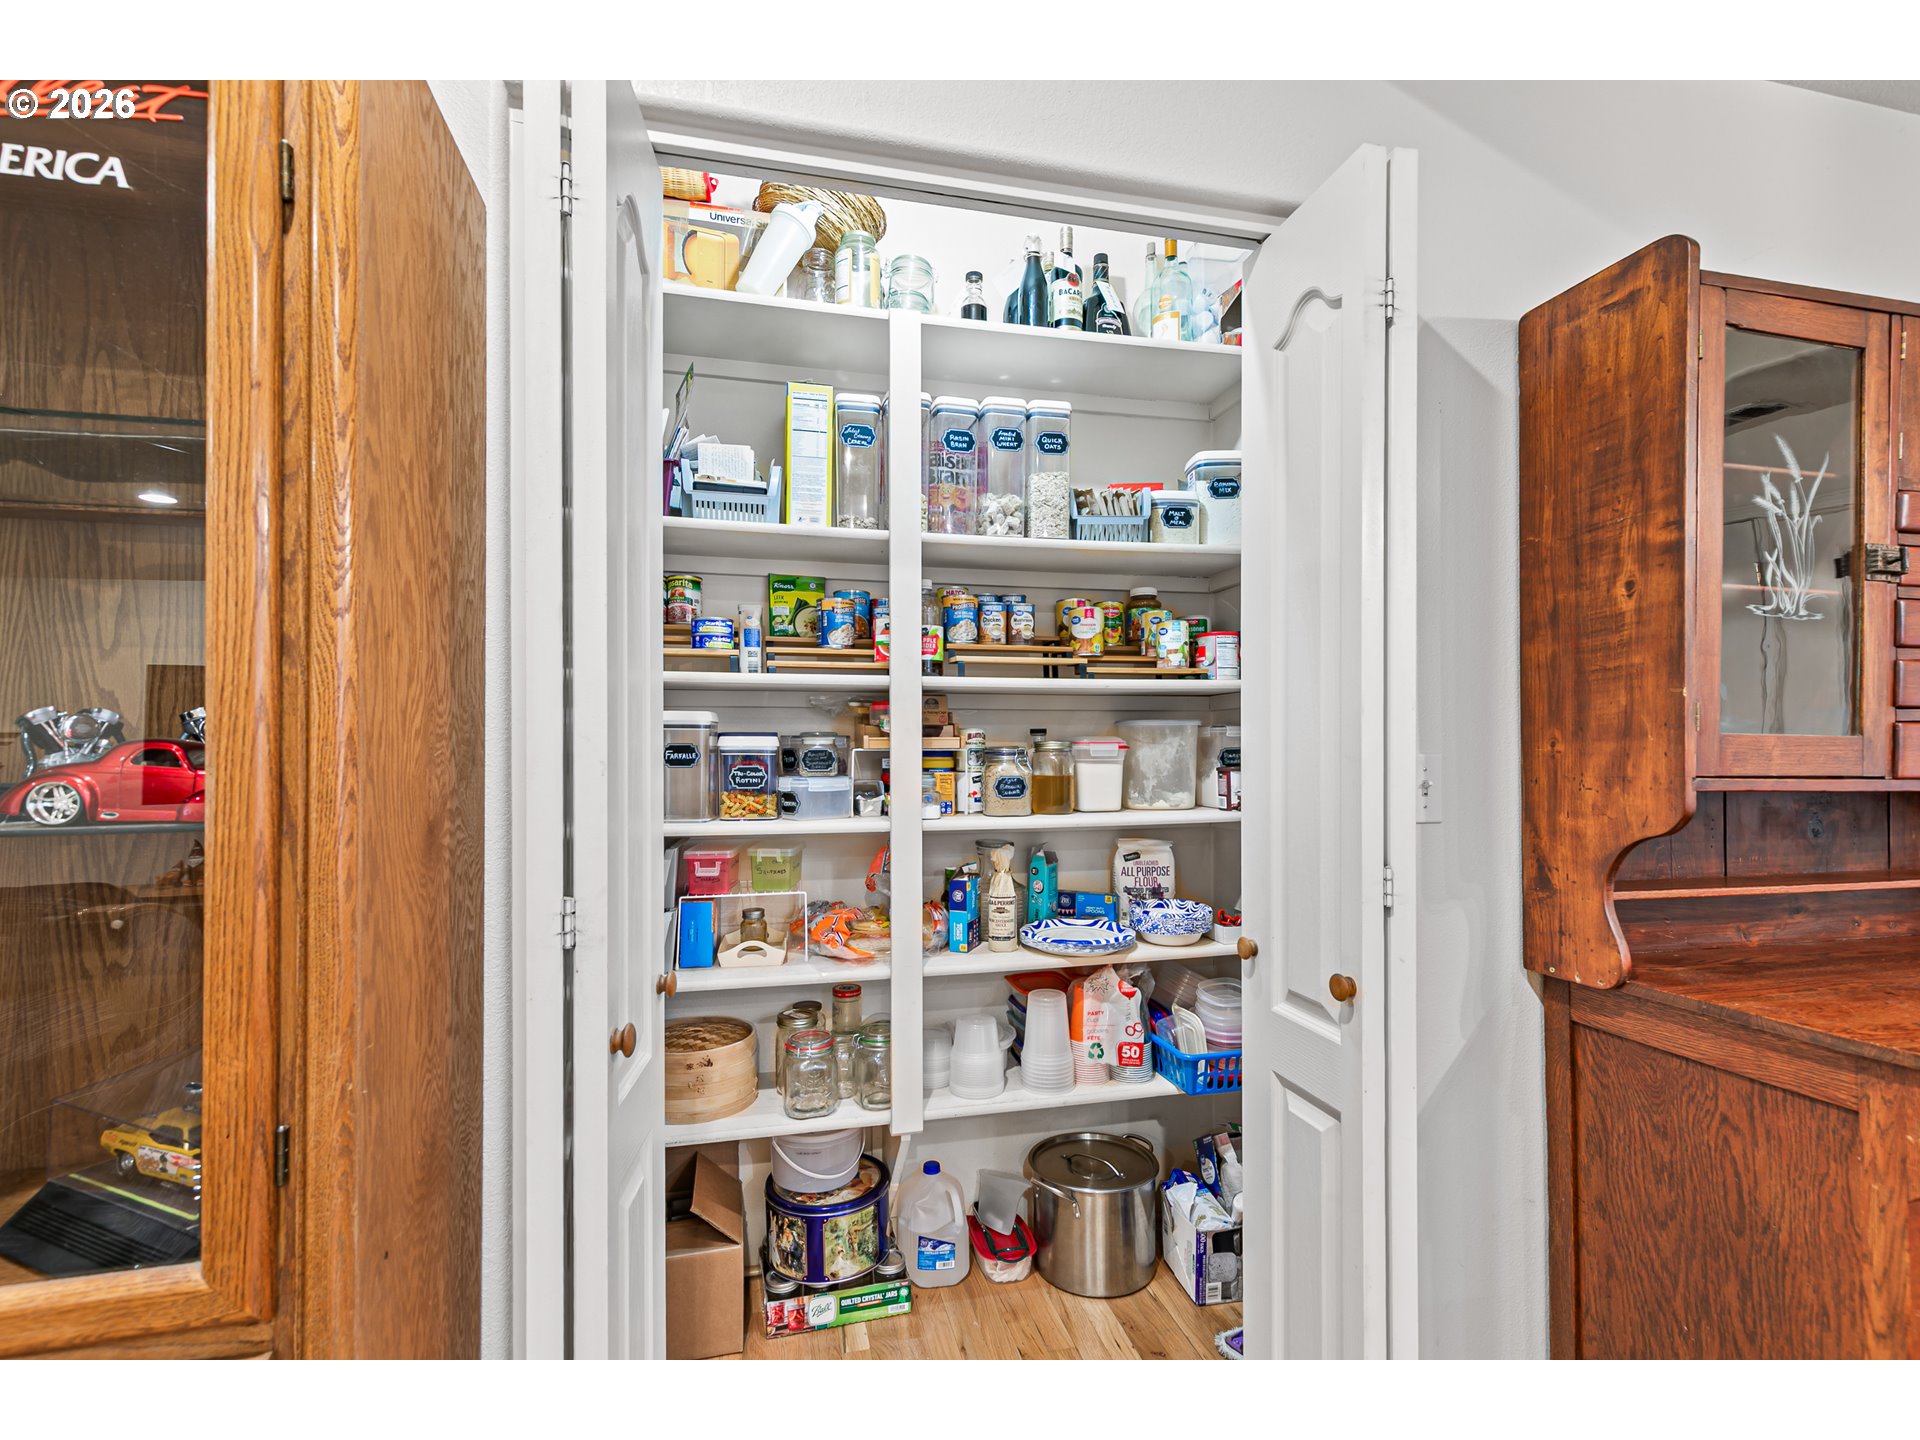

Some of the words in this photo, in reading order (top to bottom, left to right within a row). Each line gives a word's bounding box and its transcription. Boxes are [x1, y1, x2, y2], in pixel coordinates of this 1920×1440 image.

[1041, 436, 1063, 444] QUICK
[773, 582, 795, 590] Knorr
[665, 750, 697, 760] FARFALLE
[1120, 866, 1135, 876] ALL
[1136, 866, 1171, 877] PURPOSE
[1134, 876, 1159, 887] FLOUR
[1121, 1045, 1140, 1058] 50
[840, 1296, 862, 1306] QUILTED
[862, 1293, 884, 1303] CRYSTAL
[885, 1290, 898, 1299] JARS
[811, 1302, 833, 1318] Ball
